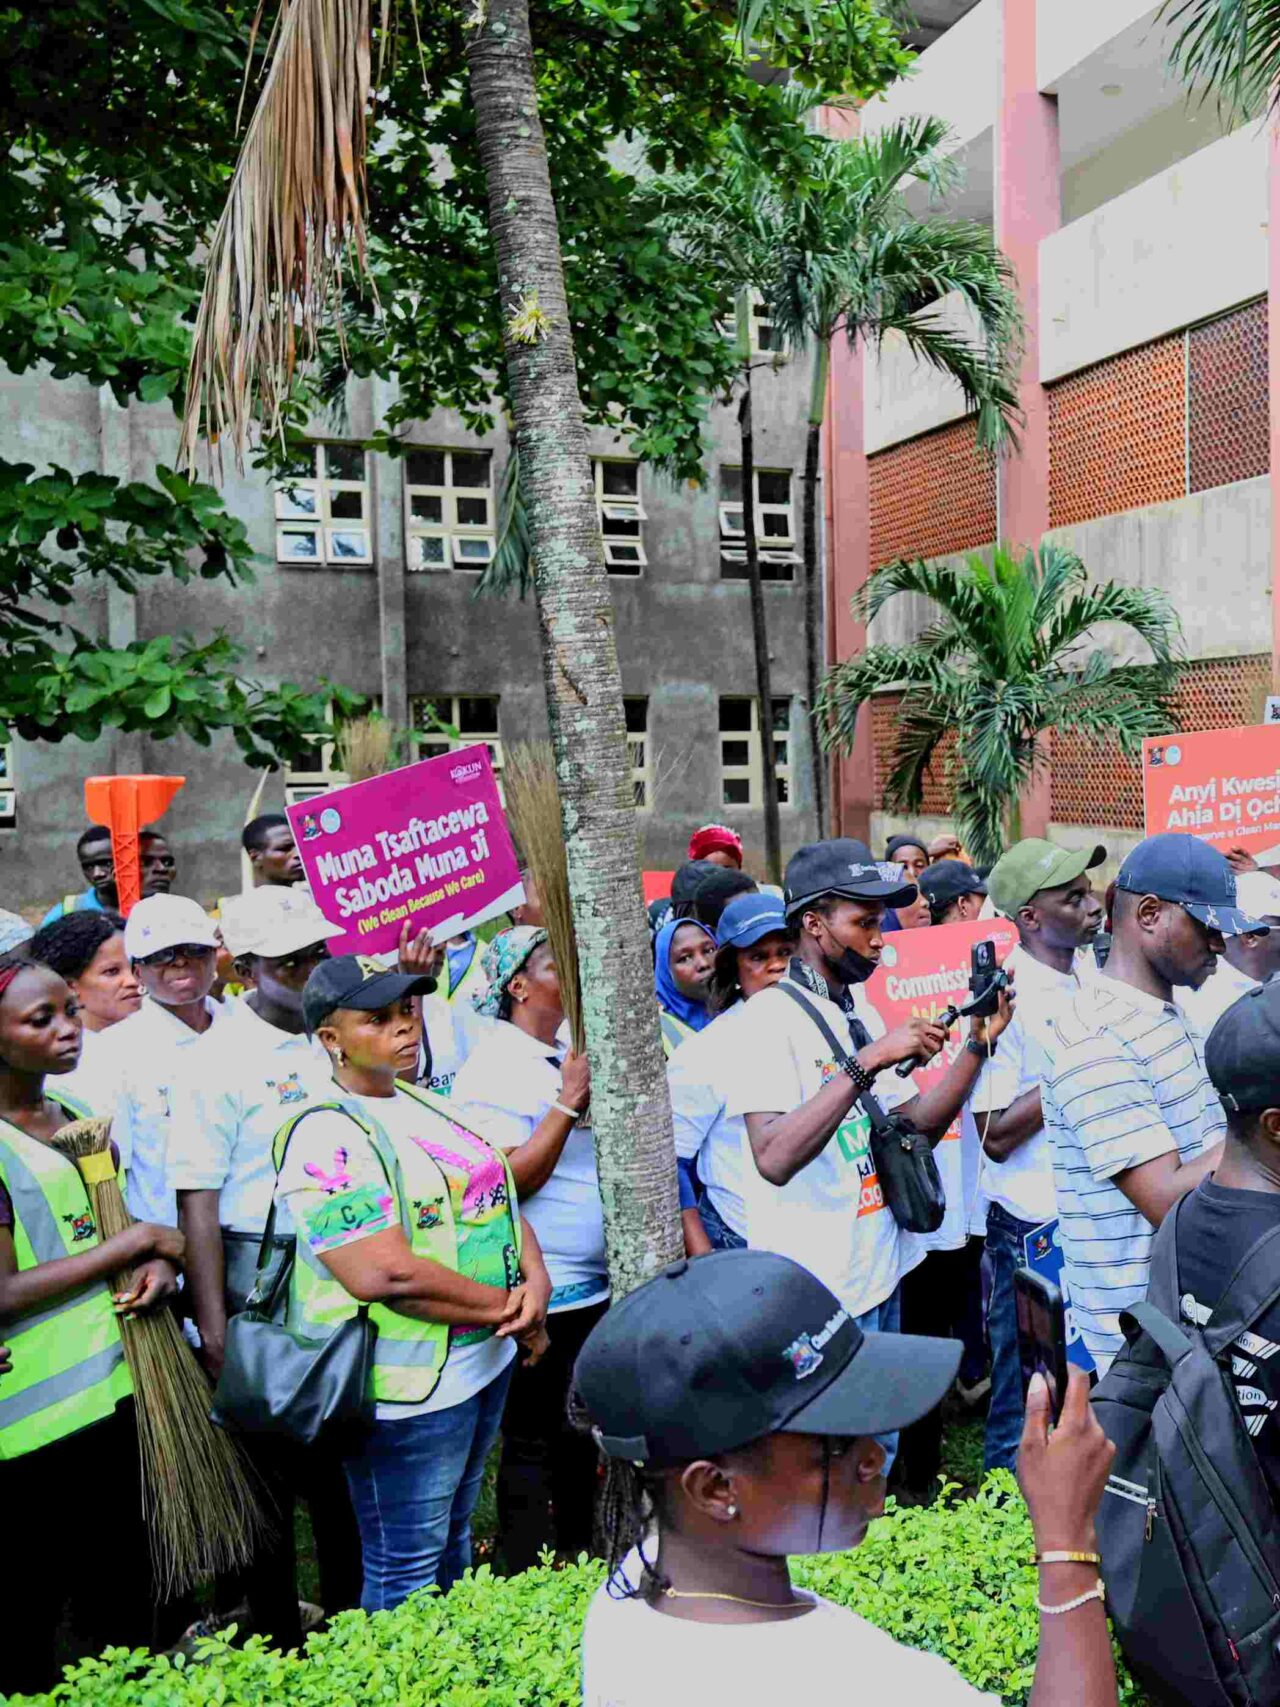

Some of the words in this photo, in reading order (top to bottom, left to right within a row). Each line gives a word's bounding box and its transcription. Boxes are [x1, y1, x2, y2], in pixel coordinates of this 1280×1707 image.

[316, 844, 378, 886] Muna
[374, 801, 490, 861] Tsaftacewa
[1235, 824, 1263, 836] Clean
[335, 863, 417, 918] Saboda
[414, 846, 470, 885] Muna
[470, 828, 491, 862] Ji
[357, 915, 380, 936] (We
[379, 904, 408, 925] Clean
[407, 888, 446, 913] Because
[444, 880, 461, 897] We
[460, 868, 486, 890] Care)
